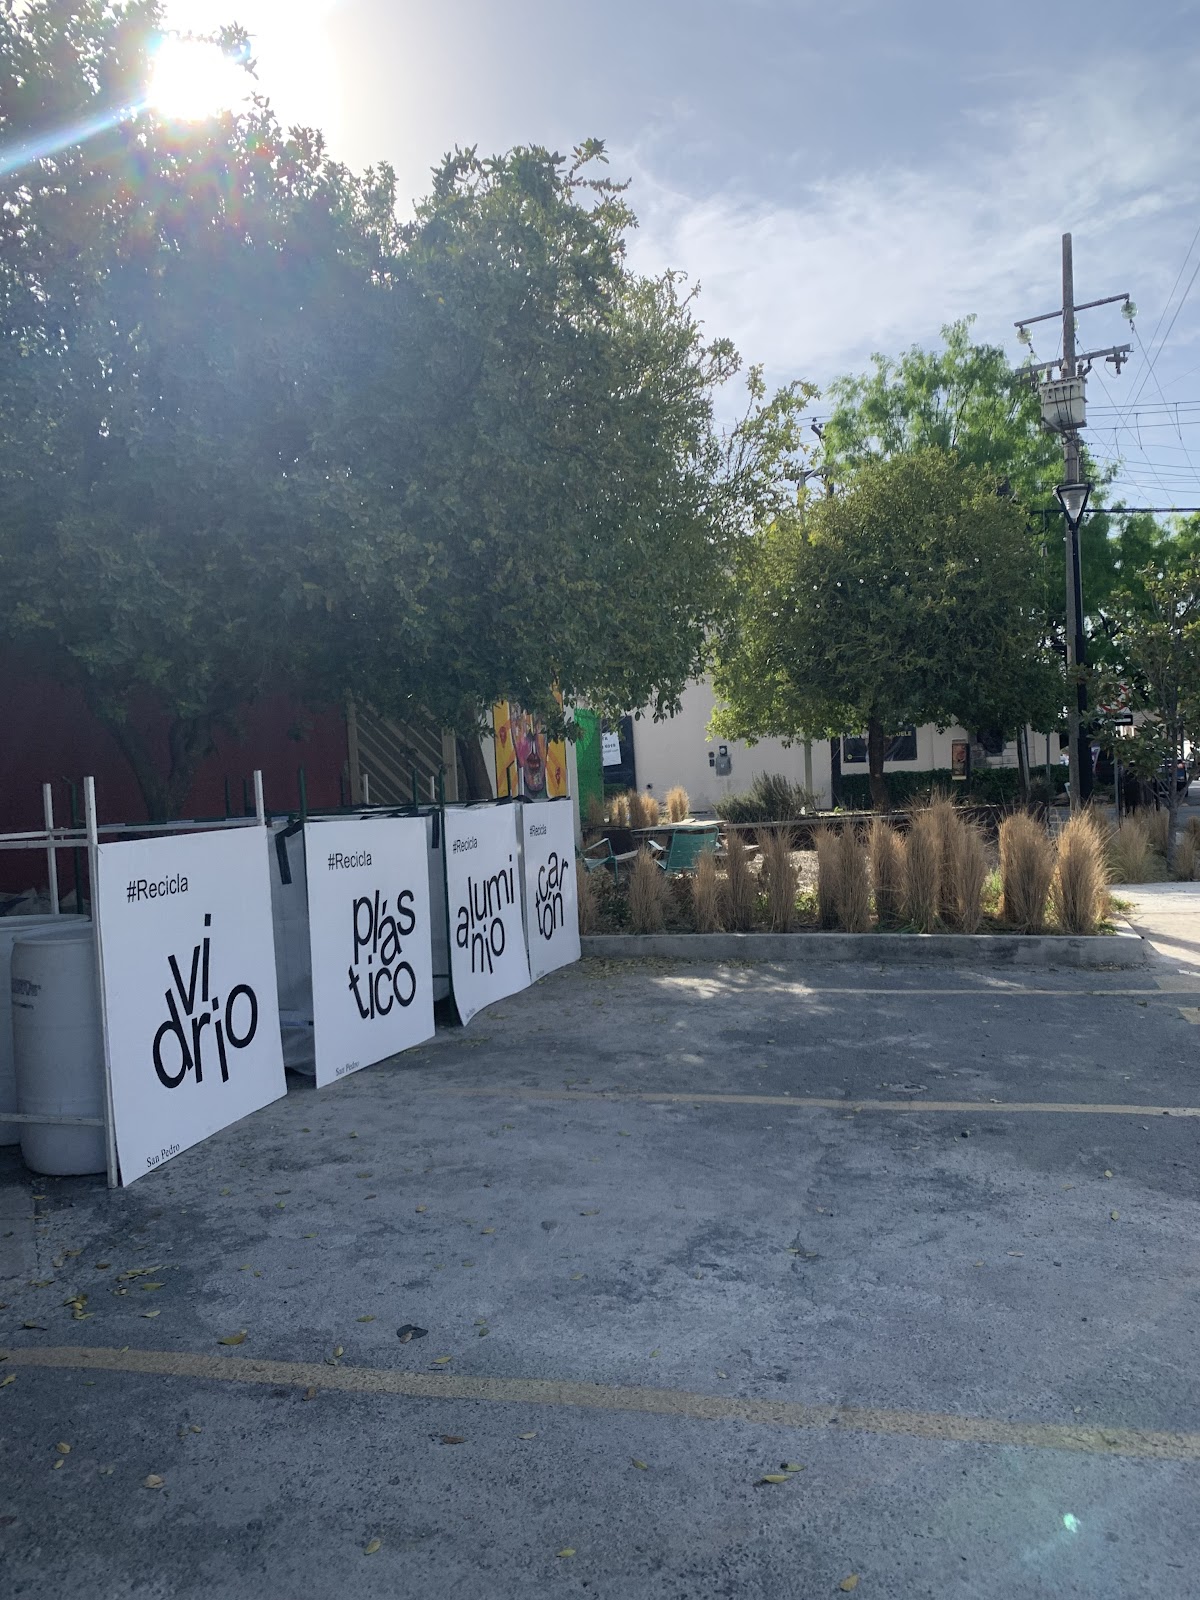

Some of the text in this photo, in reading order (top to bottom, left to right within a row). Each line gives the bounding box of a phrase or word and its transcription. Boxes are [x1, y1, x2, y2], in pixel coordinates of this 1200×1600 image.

[453, 837, 478, 854] #Recicla
[328, 851, 372, 870] #Recicla
[126, 873, 188, 903] #Recicla
[146, 1143, 181, 1168] San Pedro
